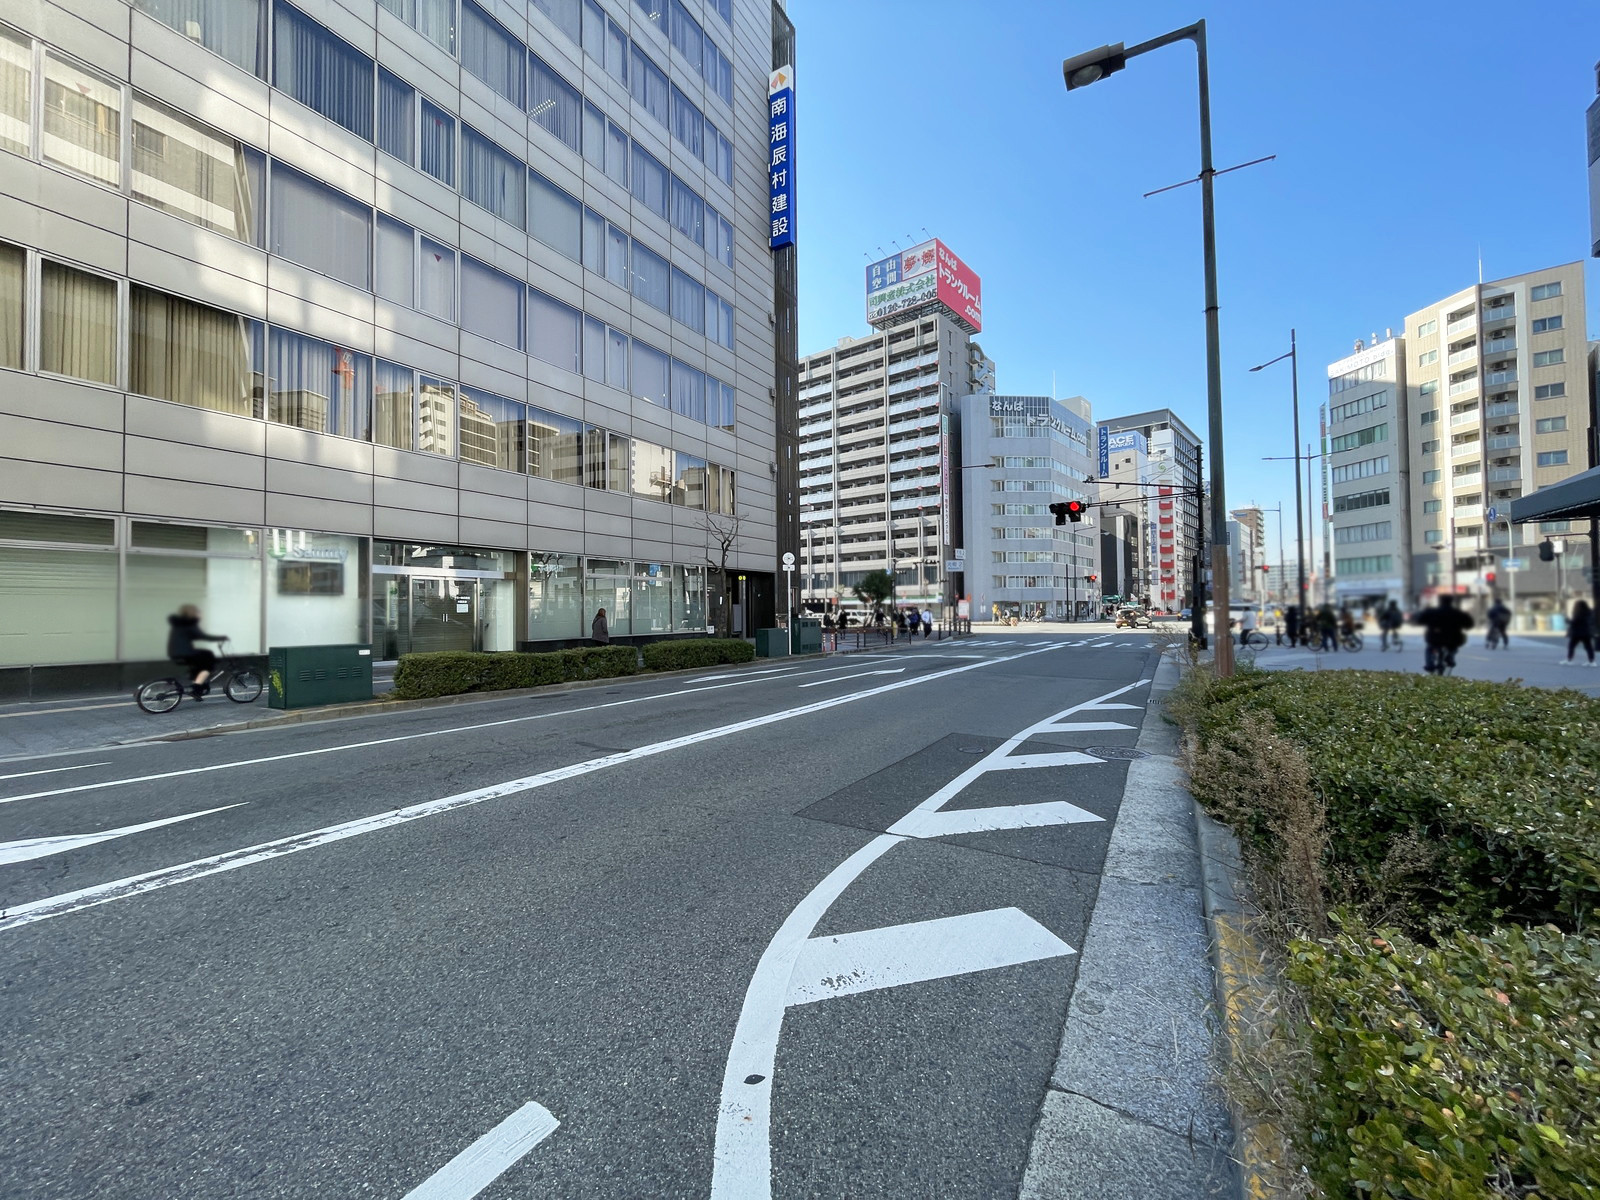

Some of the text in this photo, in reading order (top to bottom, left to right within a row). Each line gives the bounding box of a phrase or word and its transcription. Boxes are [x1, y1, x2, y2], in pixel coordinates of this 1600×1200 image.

[771, 97, 788, 236] 南海辰村建設
[992, 400, 1024, 411] なんば
[1100, 428, 1108, 477] トランクルーム
[1109, 434, 1134, 444] ACE
